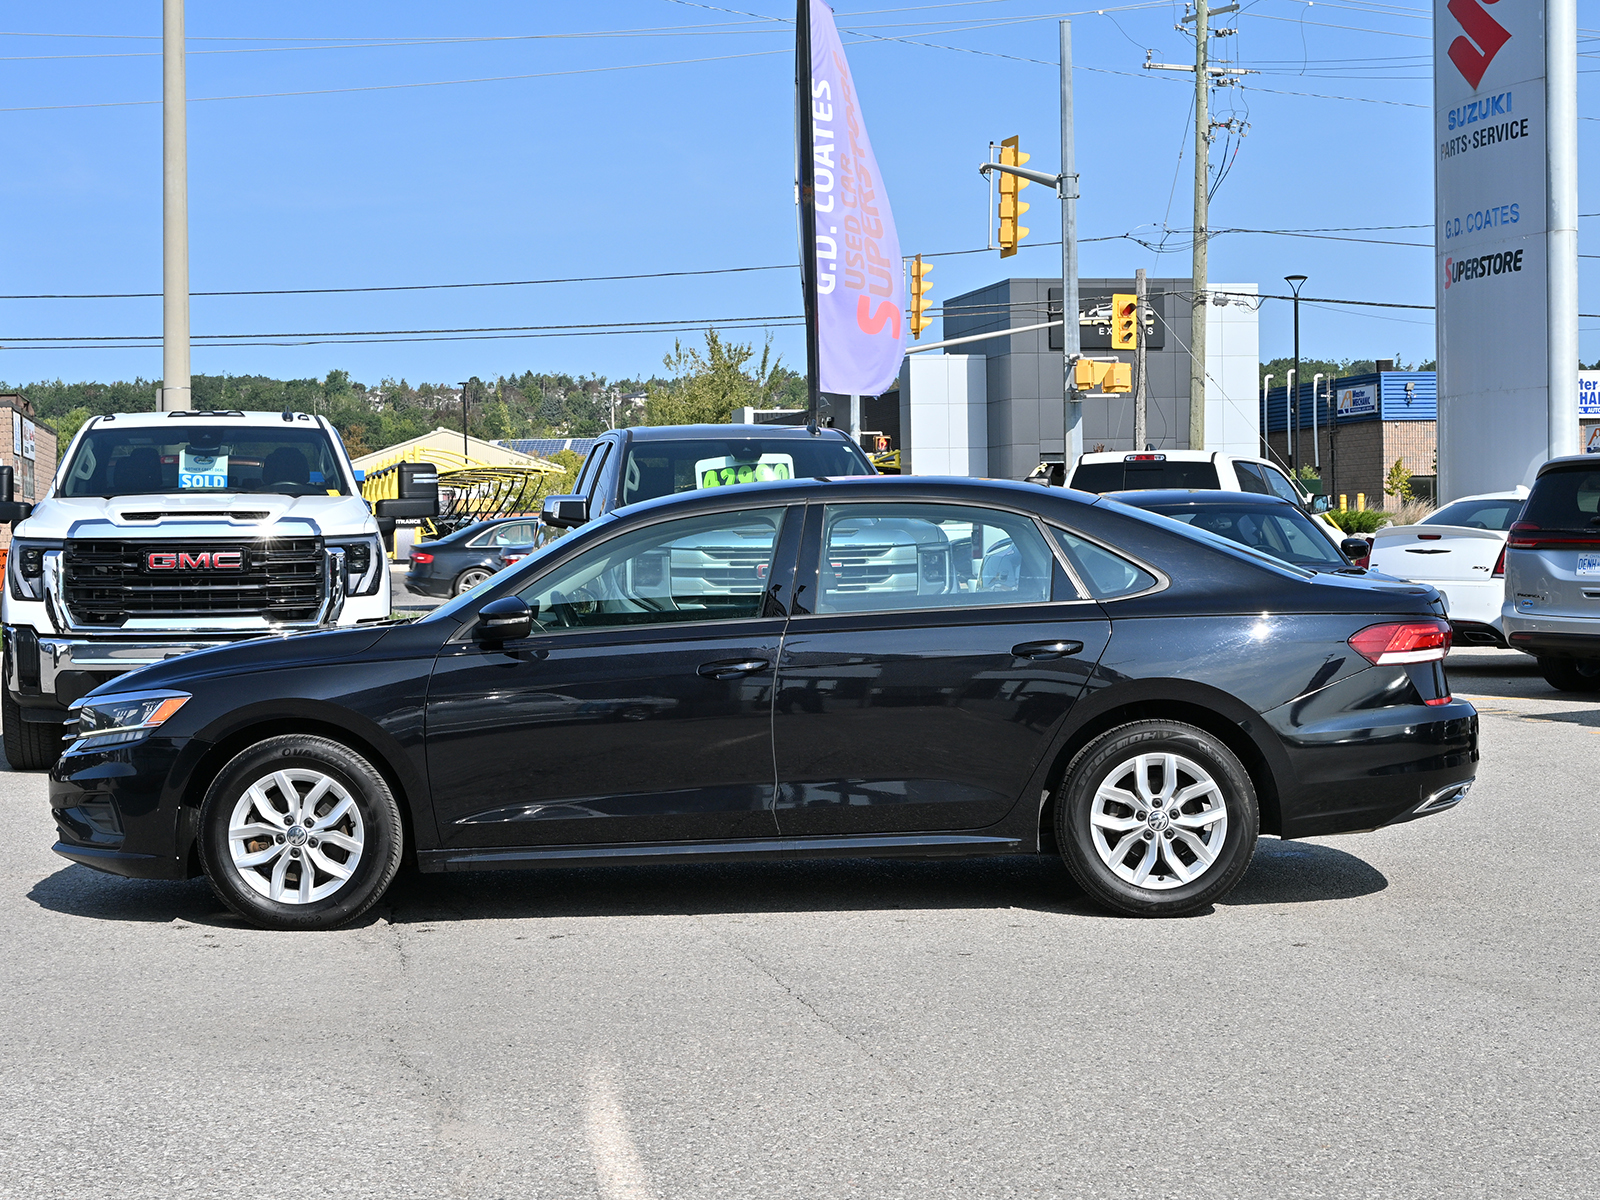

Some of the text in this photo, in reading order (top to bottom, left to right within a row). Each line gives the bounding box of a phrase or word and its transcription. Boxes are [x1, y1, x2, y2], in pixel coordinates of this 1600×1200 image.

[1448, 91, 1512, 131] SUZUKI
[812, 78, 838, 295] G.D. COATES
[833, 50, 901, 340] SUPERSTORE
[840, 153, 866, 290] USED CAR
[1445, 203, 1520, 239] G.D. COATES
[1445, 249, 1523, 289] SUPERSTORE
[181, 475, 224, 487] SOLD
[148, 552, 241, 569] GMC
